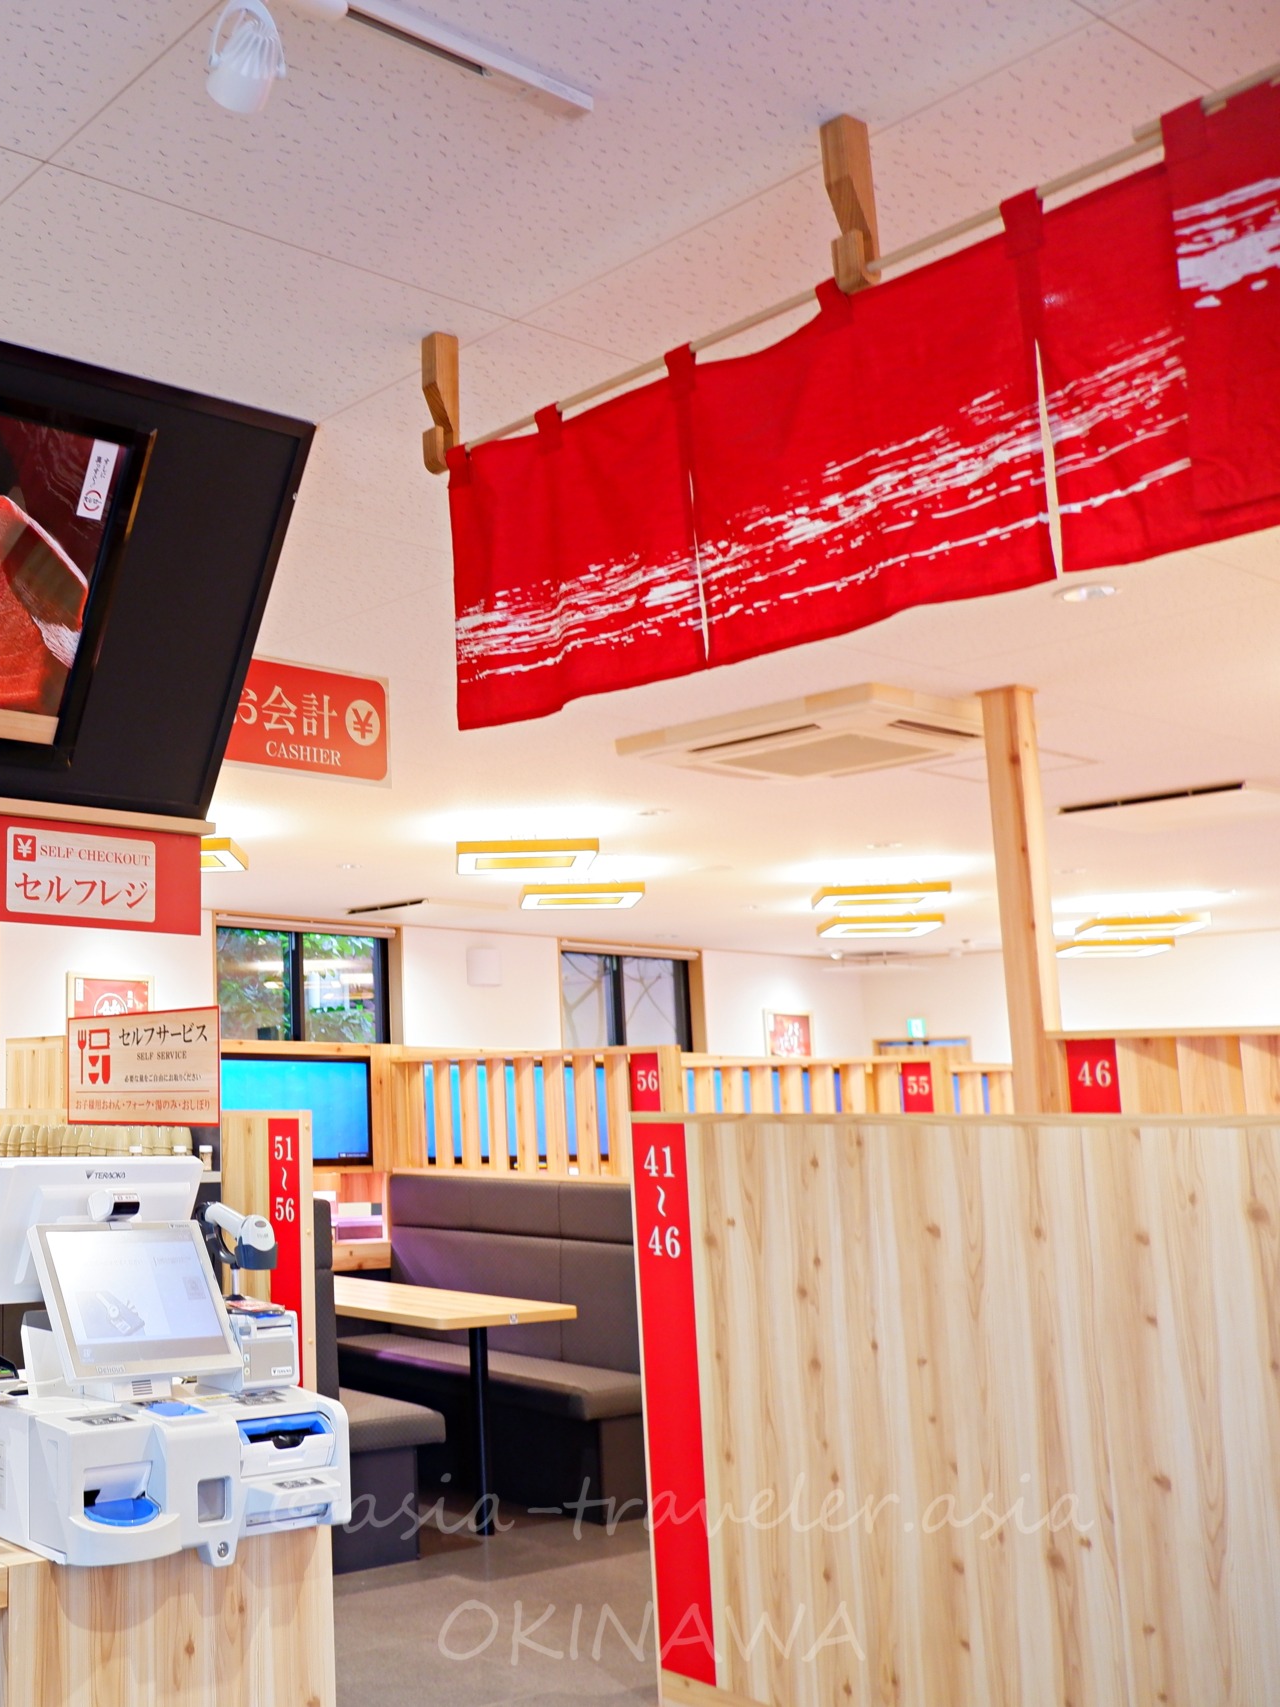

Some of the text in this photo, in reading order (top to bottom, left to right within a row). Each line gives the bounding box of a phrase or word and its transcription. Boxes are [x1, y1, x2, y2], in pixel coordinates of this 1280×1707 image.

[266, 740, 341, 767] CASHIER
[40, 844, 74, 860] SELF
[78, 849, 151, 868] CHECKOUT
[14, 872, 149, 909] セルフレジ
[119, 1022, 208, 1047] セルフサービス
[137, 1051, 187, 1061] SELF SERVICE
[636, 1070, 659, 1093] 56
[906, 1075, 931, 1097] 55
[1077, 1060, 1112, 1088] 46
[274, 1136, 294, 1161] 51
[643, 1145, 676, 1179] 41
[274, 1198, 295, 1222] 56
[648, 1225, 681, 1260] 46
